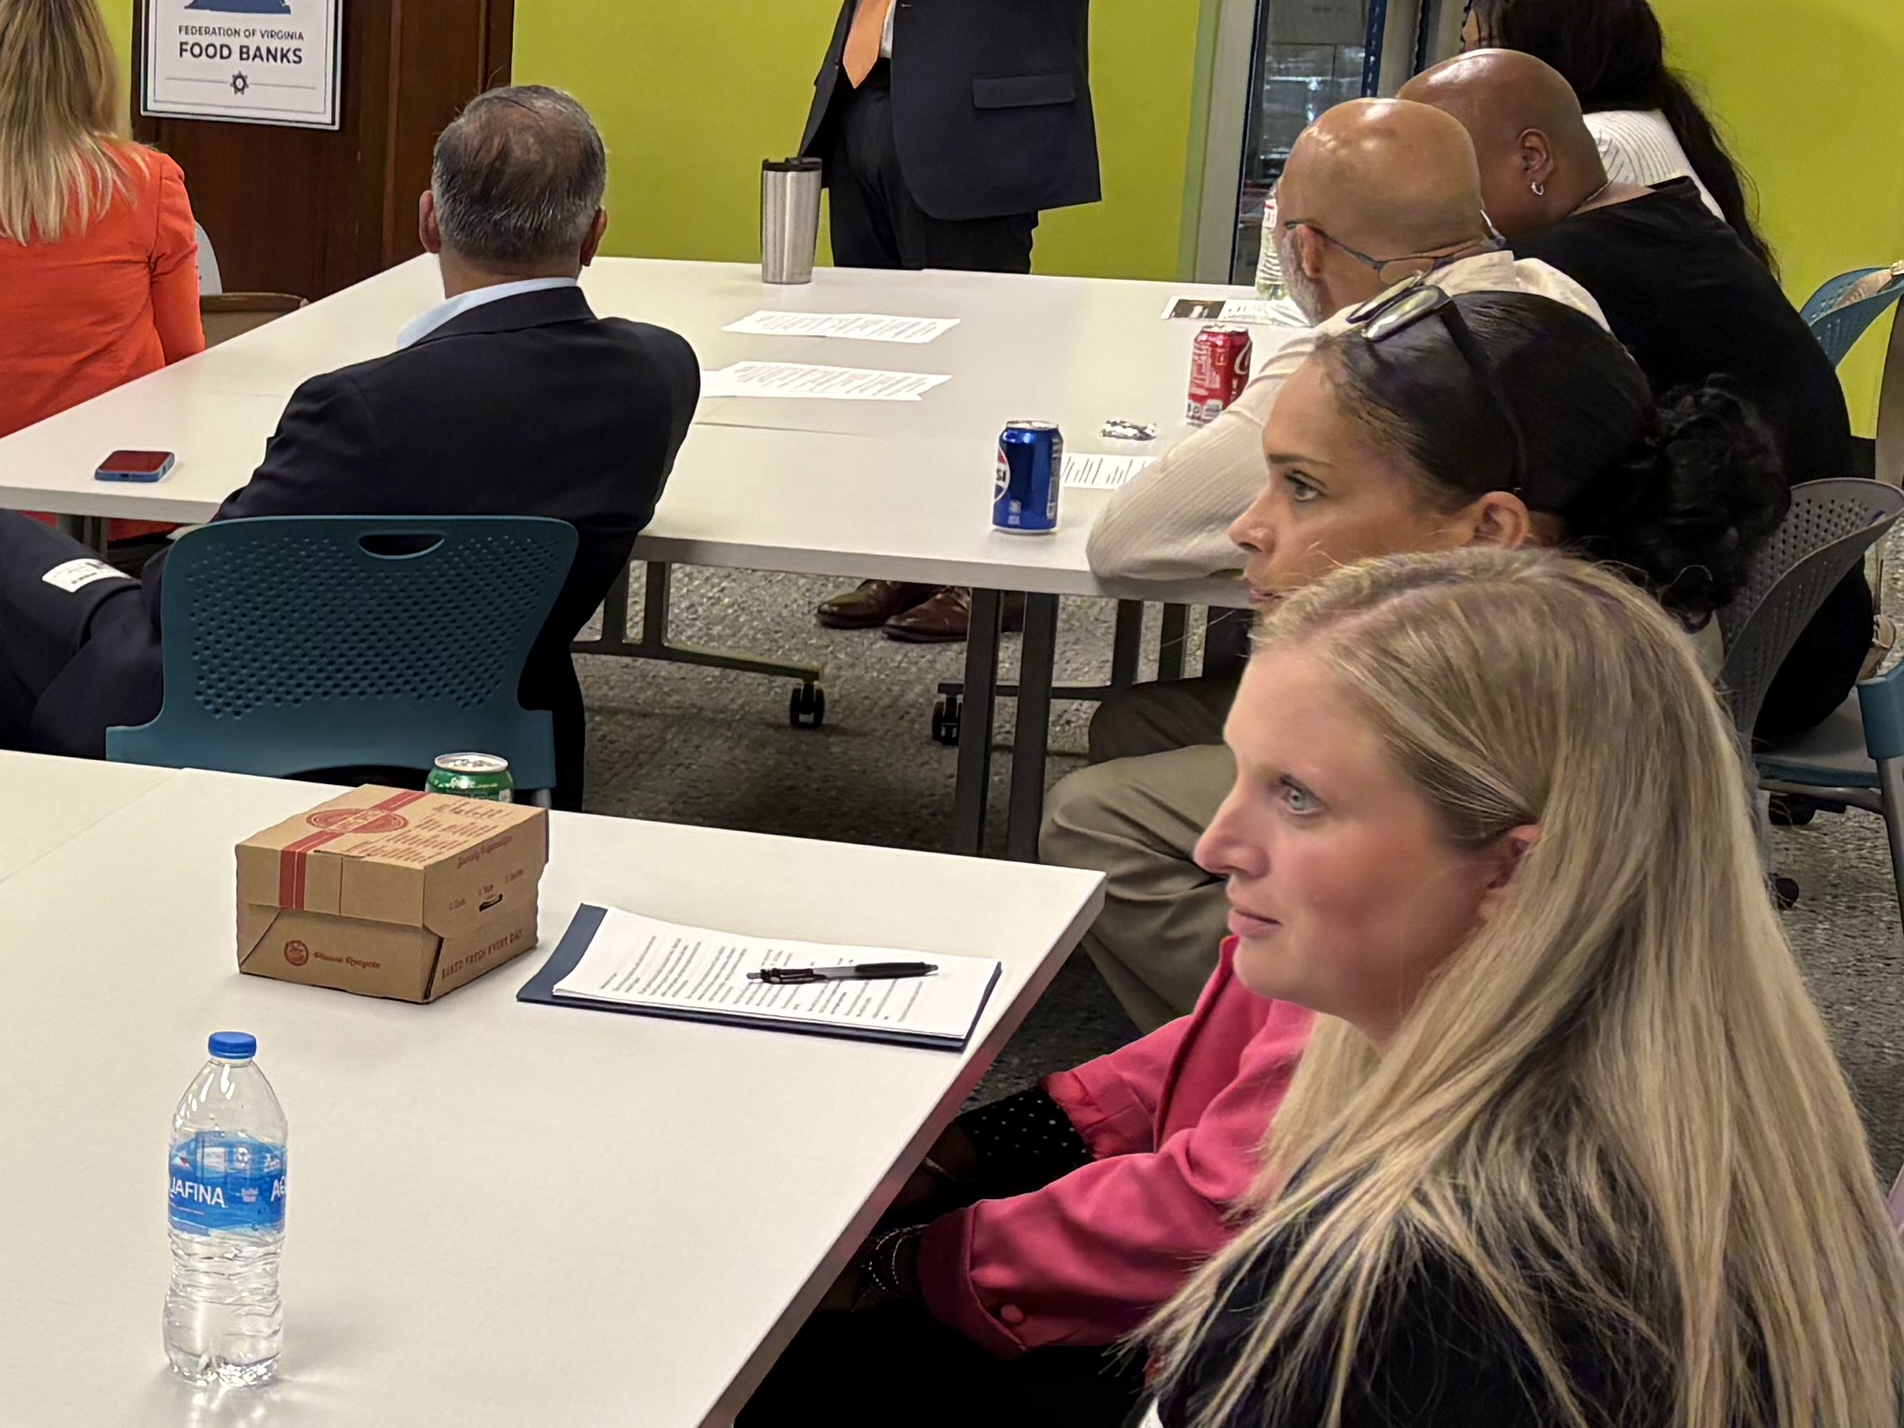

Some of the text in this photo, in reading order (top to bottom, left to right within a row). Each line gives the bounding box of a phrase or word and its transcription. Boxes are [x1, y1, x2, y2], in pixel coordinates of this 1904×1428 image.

[178, 25, 305, 41] FEDERATION OF VIRGINIA
[178, 41, 303, 65] FOOD BANKS
